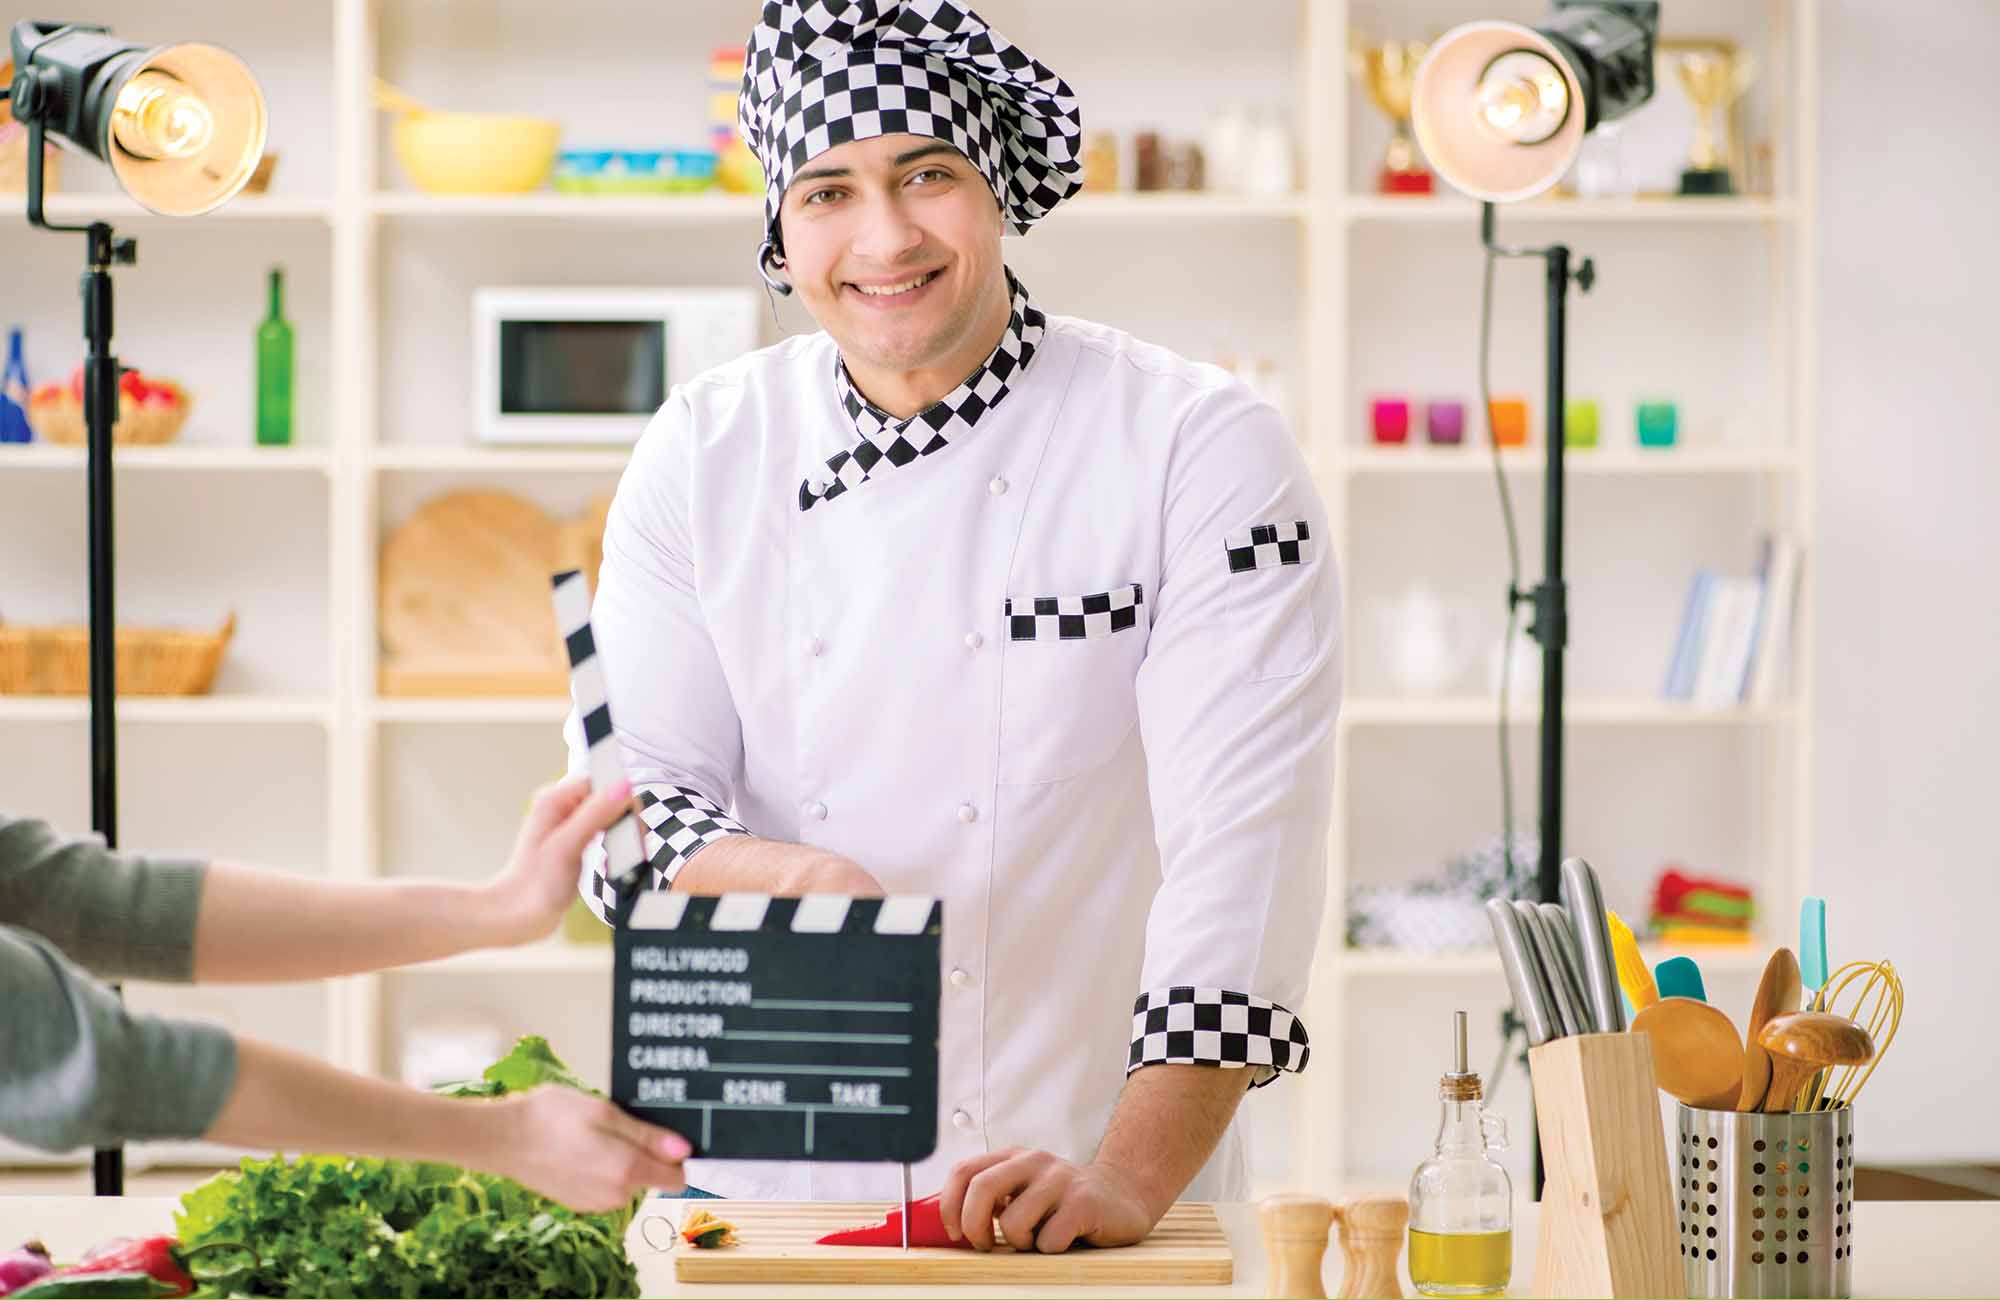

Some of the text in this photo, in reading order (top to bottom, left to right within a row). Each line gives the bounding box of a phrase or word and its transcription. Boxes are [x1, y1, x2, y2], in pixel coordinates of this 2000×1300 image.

[631, 947, 749, 973] HOLLYWOOD
[630, 979, 752, 1006] PRODUCTION
[629, 1012, 724, 1038] DIRECTOR
[628, 1046, 710, 1071] CAMERA
[637, 1078, 881, 1107] DATE SCENE TAKE
